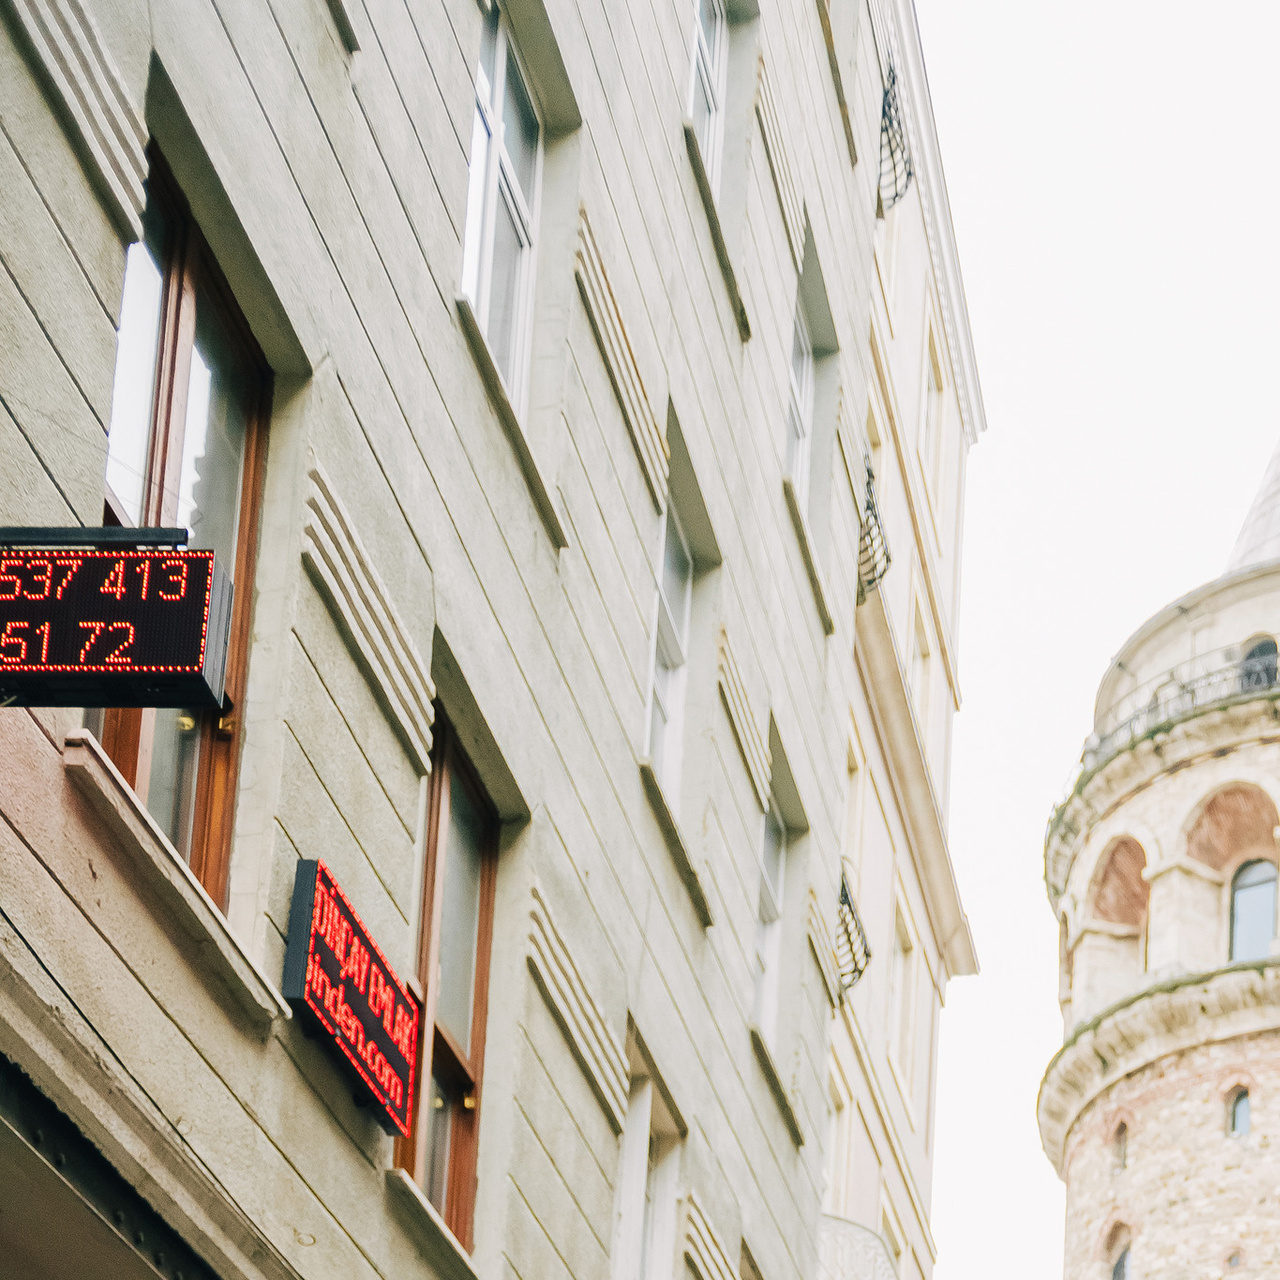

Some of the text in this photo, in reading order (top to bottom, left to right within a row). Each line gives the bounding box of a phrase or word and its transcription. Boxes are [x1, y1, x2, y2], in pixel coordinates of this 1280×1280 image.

[0, 559, 188, 600] 537 413
[0, 621, 135, 663] 51 72
[368, 962, 414, 1066] EMLAK
